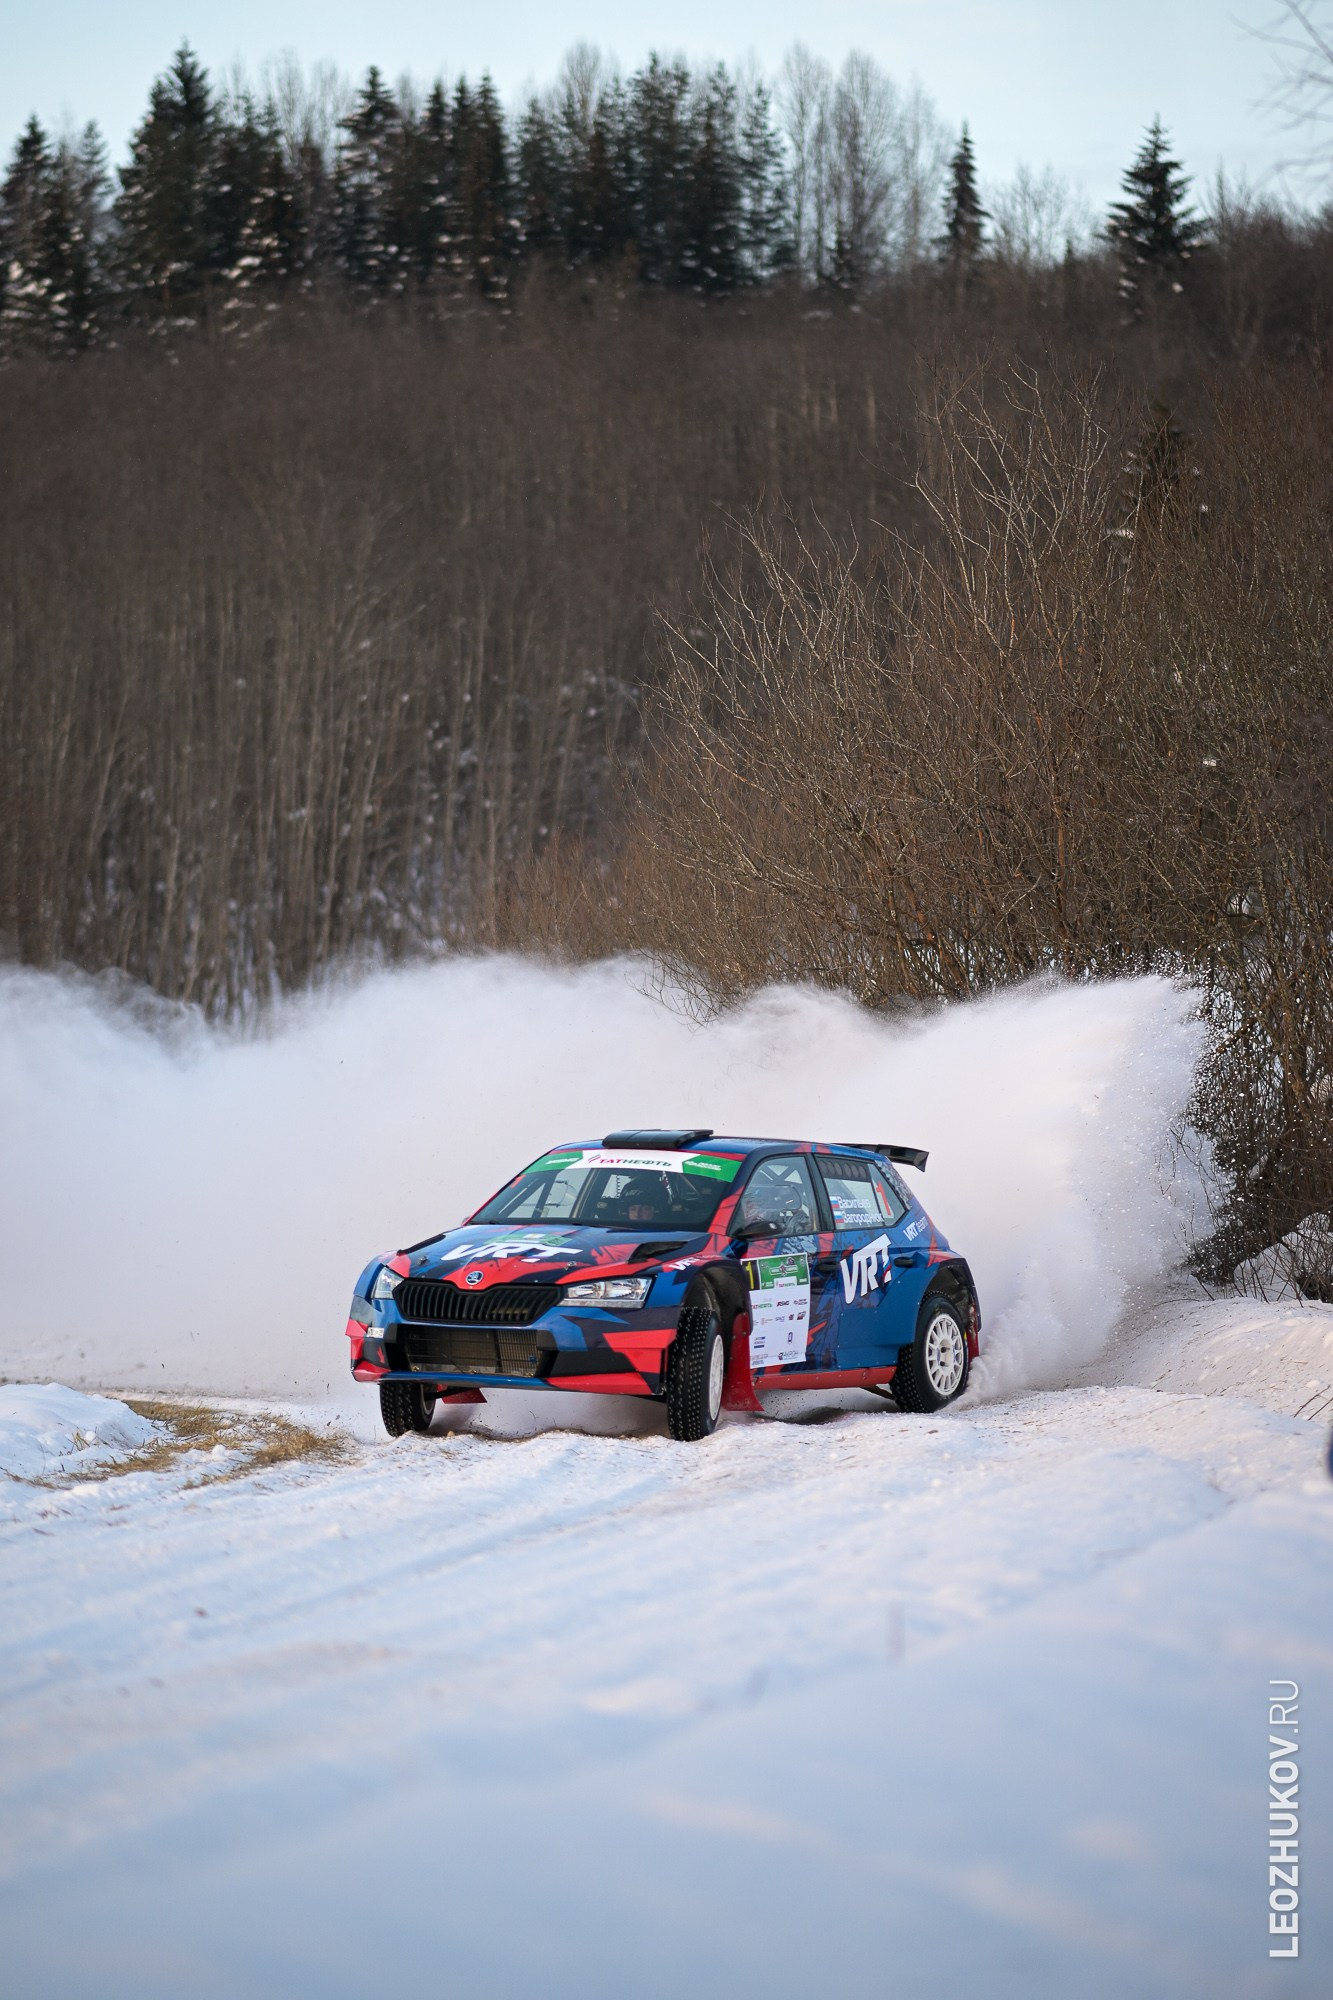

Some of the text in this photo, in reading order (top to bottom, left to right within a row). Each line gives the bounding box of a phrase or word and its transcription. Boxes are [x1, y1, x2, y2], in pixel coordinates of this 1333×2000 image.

[600, 1159, 672, 1167] ТАТНЕФТЬ
[876, 1182, 891, 1216] 1
[903, 1221, 919, 1241] VRT
[440, 1242, 583, 1263] VRT
[668, 1256, 700, 1271] VRT
[840, 1233, 892, 1304] VRT
[745, 1261, 755, 1289] 1
